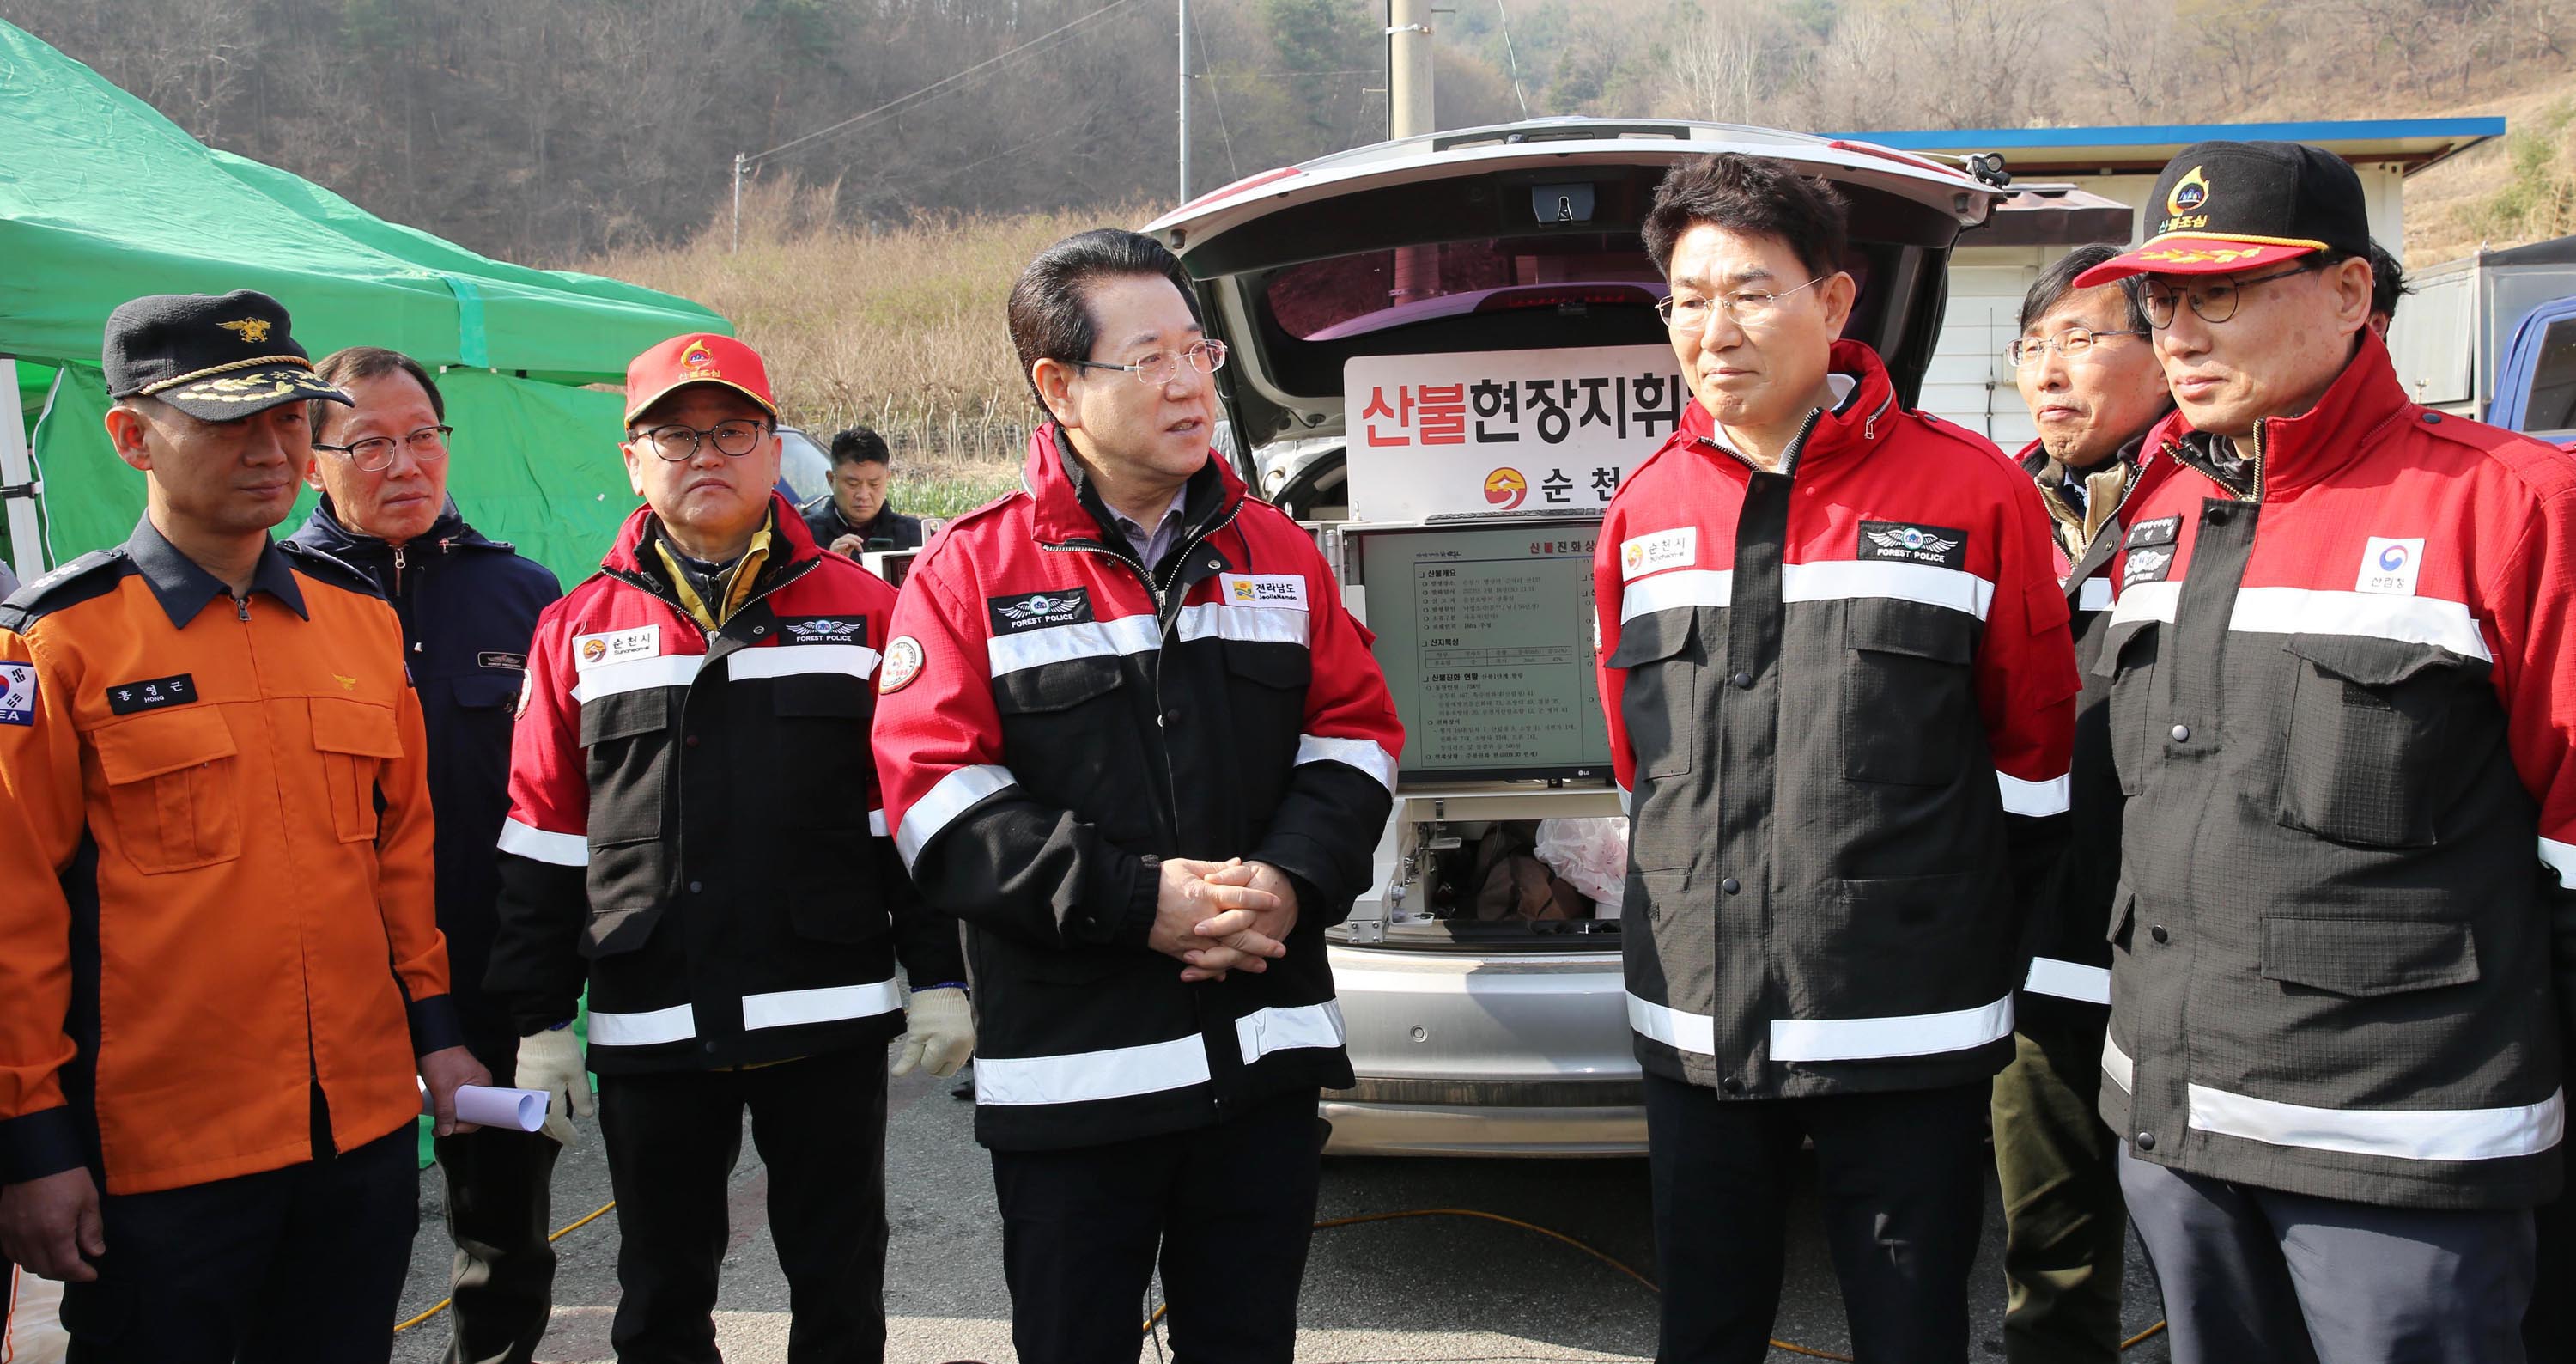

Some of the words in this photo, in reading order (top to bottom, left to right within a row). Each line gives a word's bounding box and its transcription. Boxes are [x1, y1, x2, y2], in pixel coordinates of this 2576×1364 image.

[1362, 372, 1695, 448] 산불현장지휘
[1877, 548, 1911, 557] FOREST
[1914, 551, 1945, 563] POLICE
[1255, 583, 1296, 594] 전라남도
[2371, 577, 2405, 589] 산림청
[1011, 617, 1042, 628] FOREST
[1045, 613, 1074, 623] POLICE
[612, 633, 650, 649] 순천시
